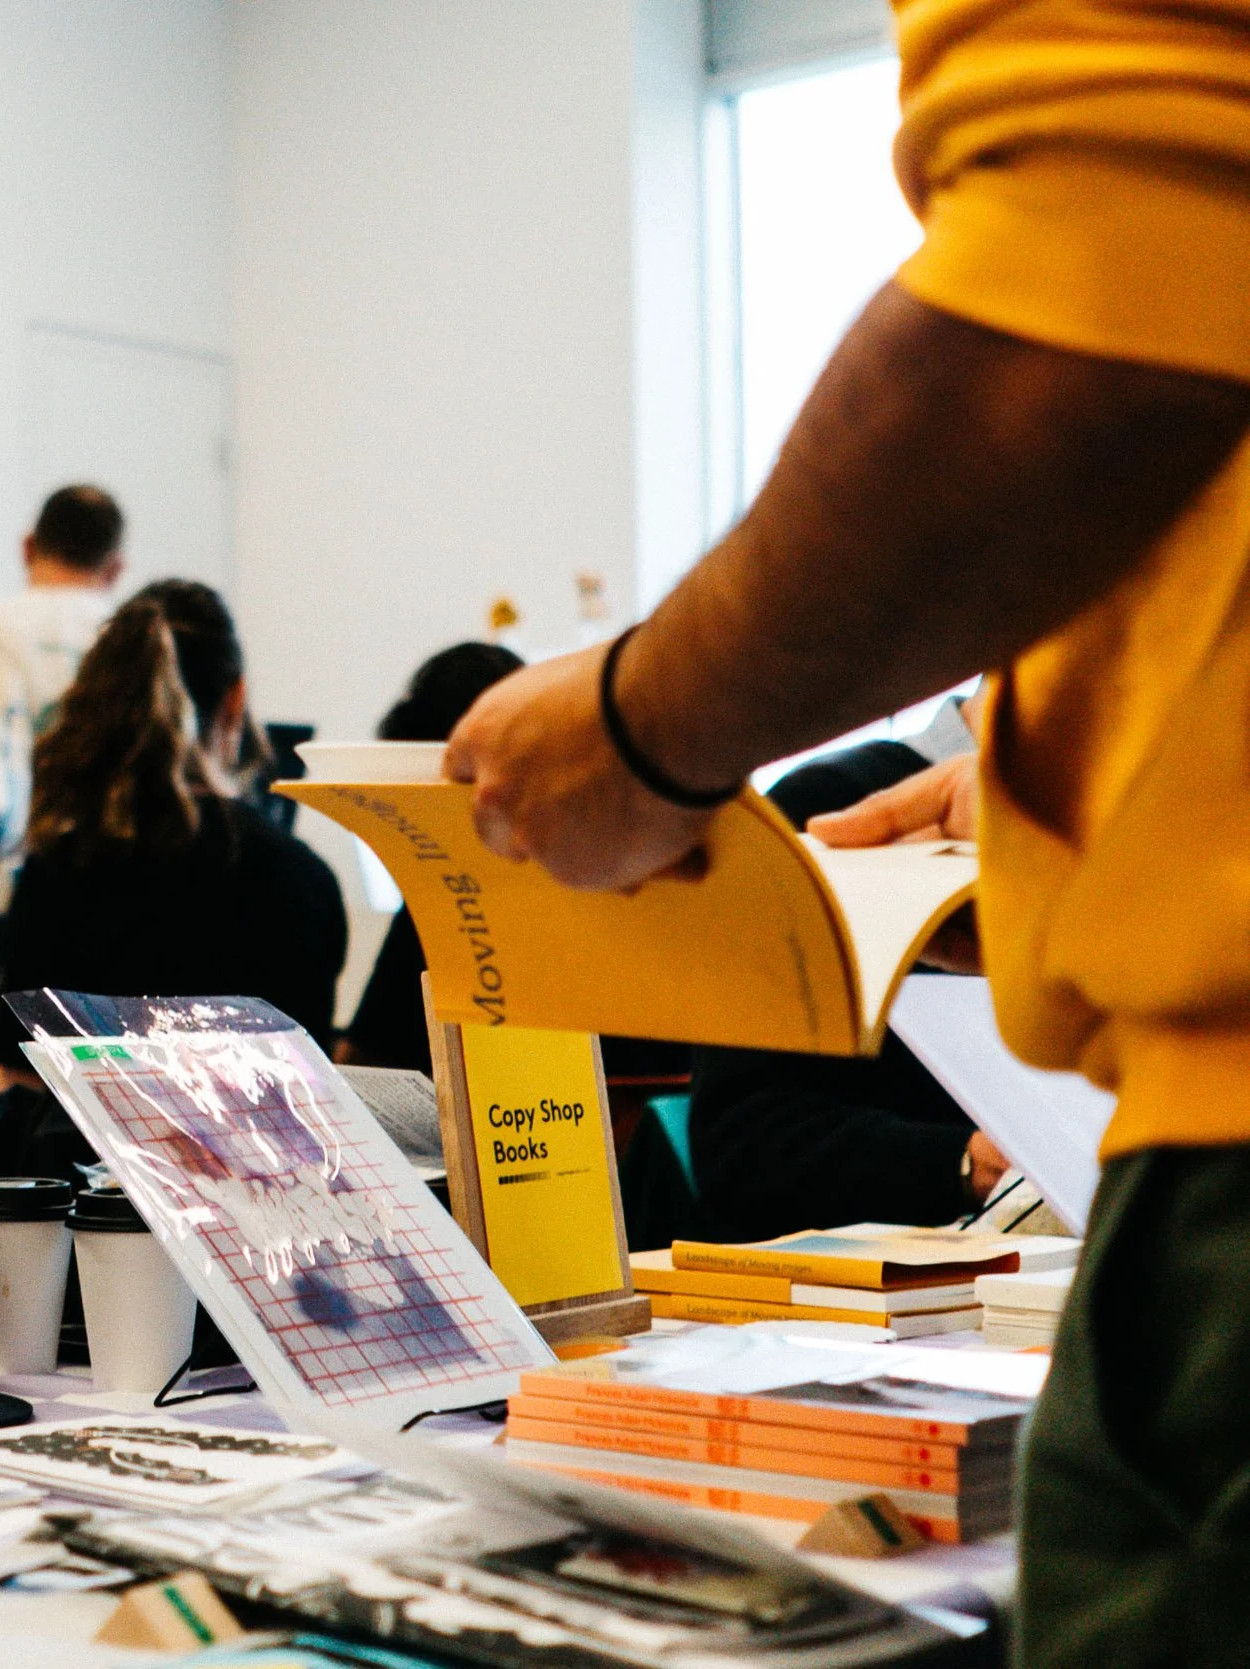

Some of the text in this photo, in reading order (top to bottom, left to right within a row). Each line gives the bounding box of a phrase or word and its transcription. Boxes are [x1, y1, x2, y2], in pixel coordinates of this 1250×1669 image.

[442, 873, 506, 1027] Moving
[488, 1098, 585, 1133] Copy Shop
[493, 1136, 549, 1164] Books
[685, 1251, 736, 1268] Landscape
